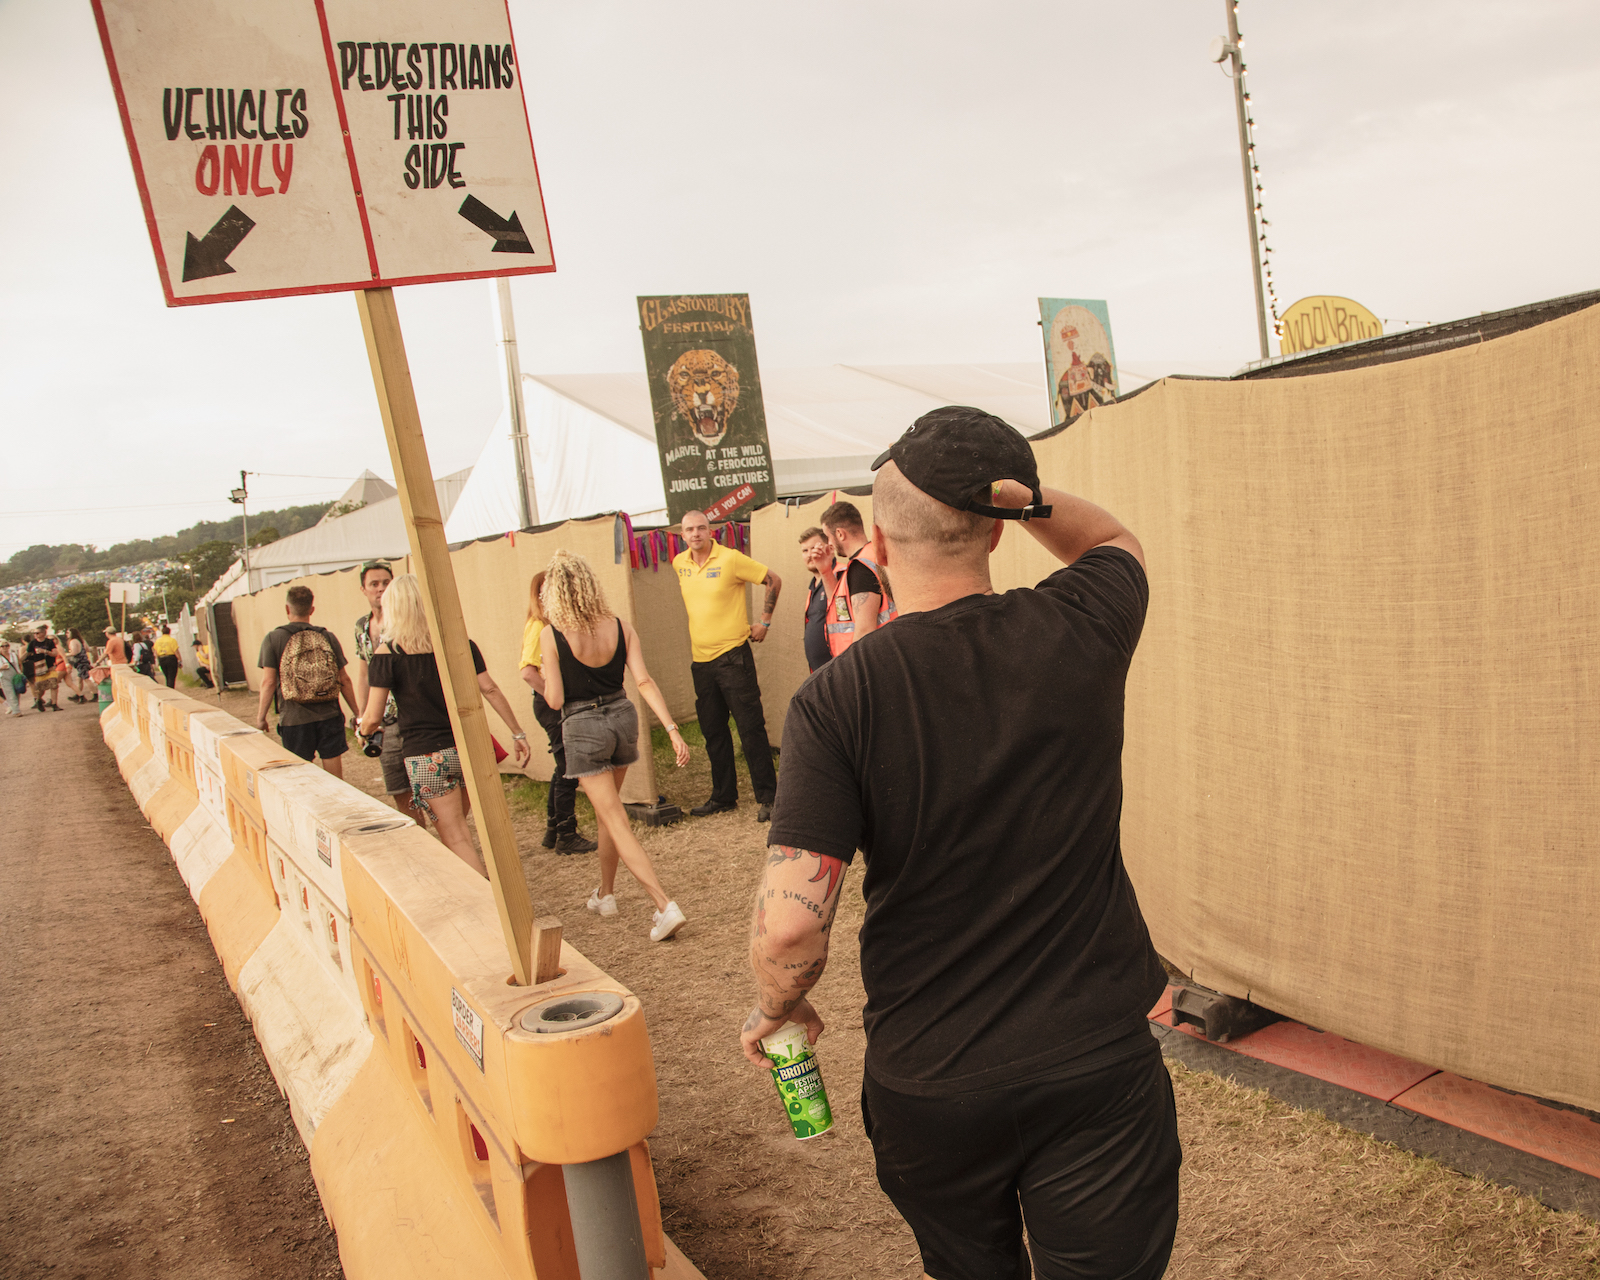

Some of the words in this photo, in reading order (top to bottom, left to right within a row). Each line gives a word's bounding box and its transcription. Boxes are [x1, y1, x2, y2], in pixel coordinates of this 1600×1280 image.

[336, 41, 514, 91] PEDESTRIANS
[163, 88, 309, 141] VEHICLES
[387, 93, 449, 140] THIS
[195, 143, 294, 197] ONLY
[403, 142, 466, 190] SIDE
[641, 297, 748, 331] GLASTONBURY
[663, 320, 734, 334] FESTIVAL
[665, 445, 702, 467] MARVEL
[705, 449, 717, 460] AT
[721, 447, 738, 458] THE
[741, 444, 763, 456] WILD
[717, 455, 767, 470] FEROCIOUS
[669, 477, 708, 493] JUNGLE
[713, 470, 770, 488] CREATURES
[707, 508, 720, 521] HILE
[721, 496, 737, 511] YOU
[736, 486, 752, 500] CAN
[679, 568, 692, 577] 513
[783, 890, 823, 919] SINCERE
[798, 1078, 822, 1096] APPLE
